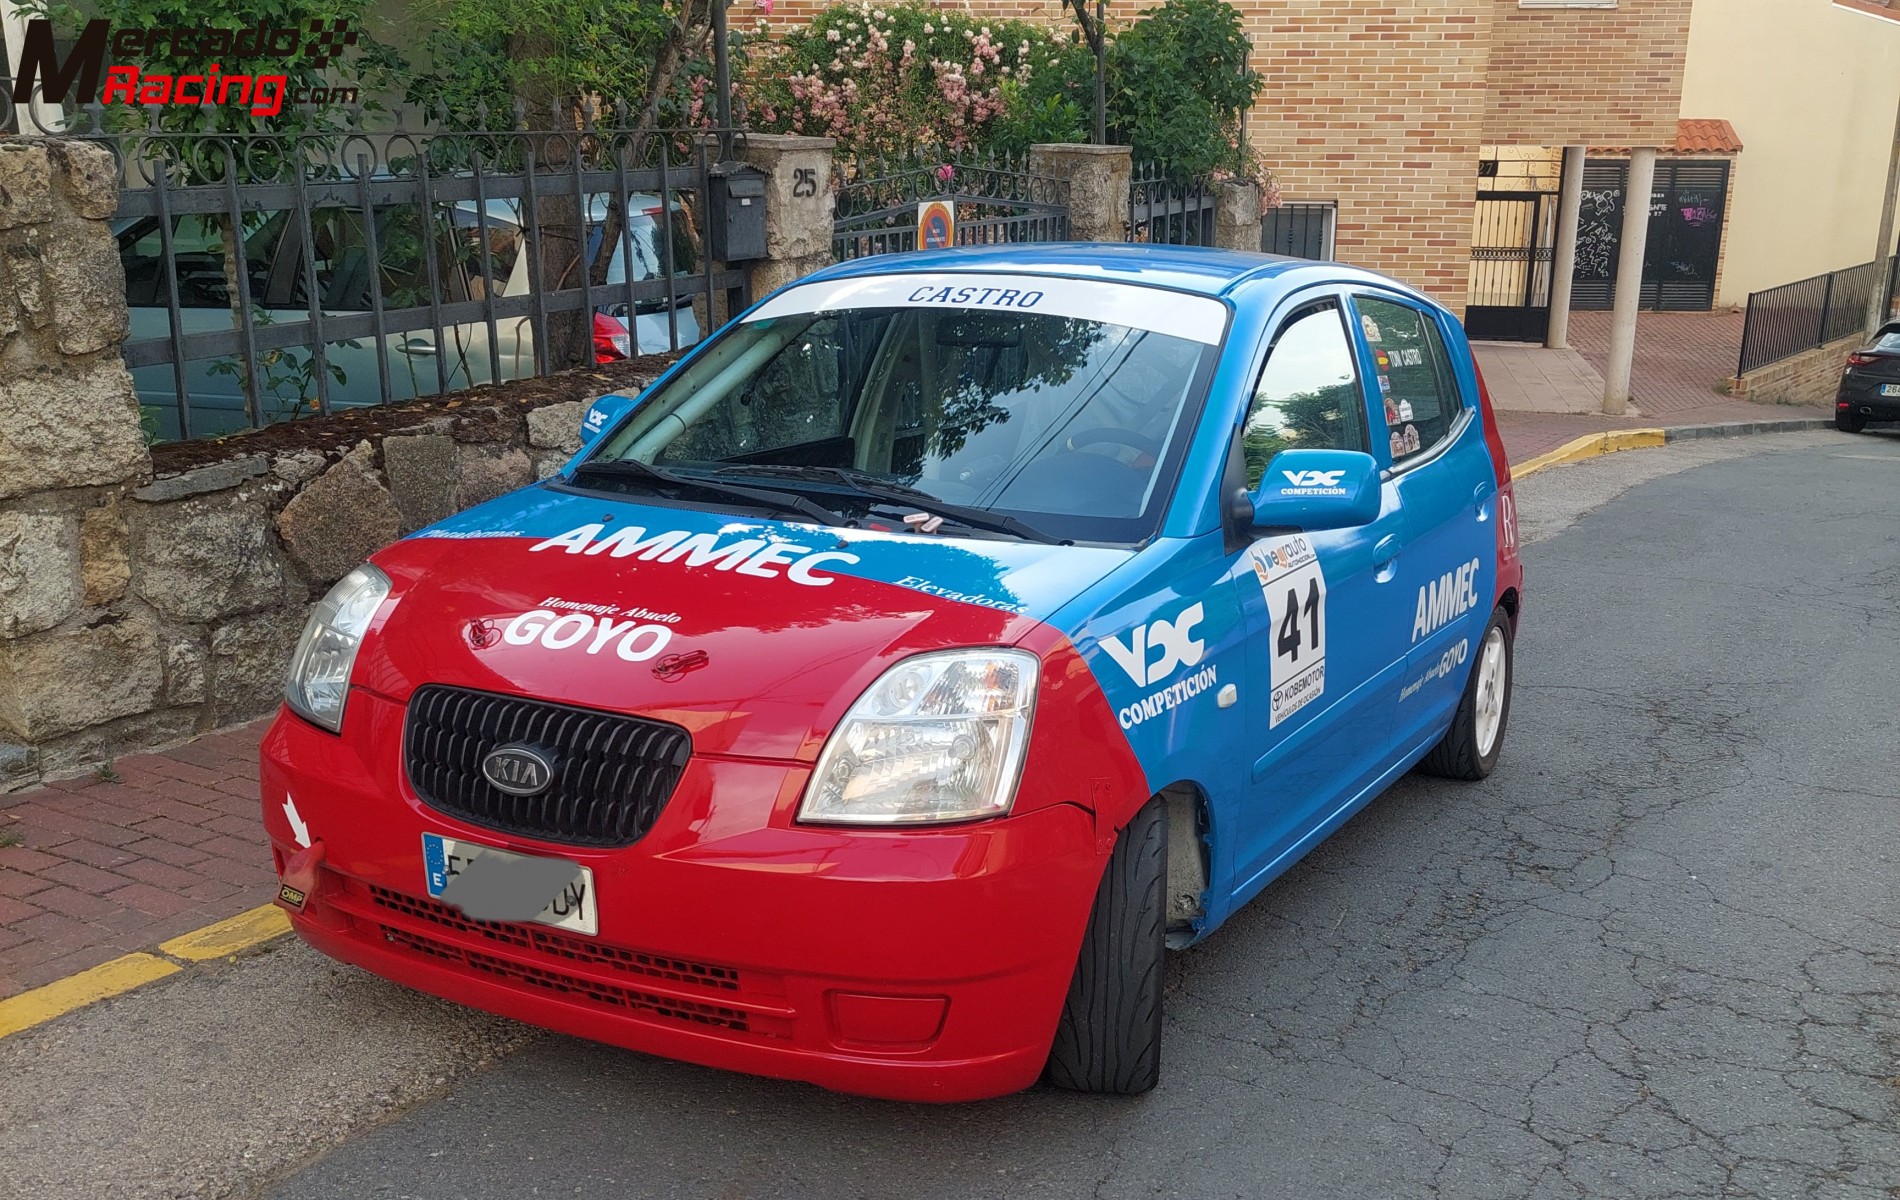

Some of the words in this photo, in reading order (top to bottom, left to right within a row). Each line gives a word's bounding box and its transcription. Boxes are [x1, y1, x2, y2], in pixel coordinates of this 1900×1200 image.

[793, 168, 817, 197] 25
[908, 286, 1044, 308] CASTRO
[1280, 485, 1346, 495] COMPETICIÓN
[528, 523, 860, 586] AMMEC
[538, 596, 621, 618] Homenaje
[619, 607, 683, 623] Abuelo
[892, 575, 1030, 613] Elevadoras
[1411, 557, 1479, 643] AMMEC
[503, 609, 673, 662] GOYO
[1277, 576, 1320, 663] 41
[1438, 638, 1468, 679] GOYO
[1118, 664, 1218, 730] COMPETICIÓN
[1284, 665, 1325, 703] KOBEMOTOR
[494, 756, 538, 786] KIA
[281, 889, 303, 902] OMP
[432, 872, 443, 887] E
